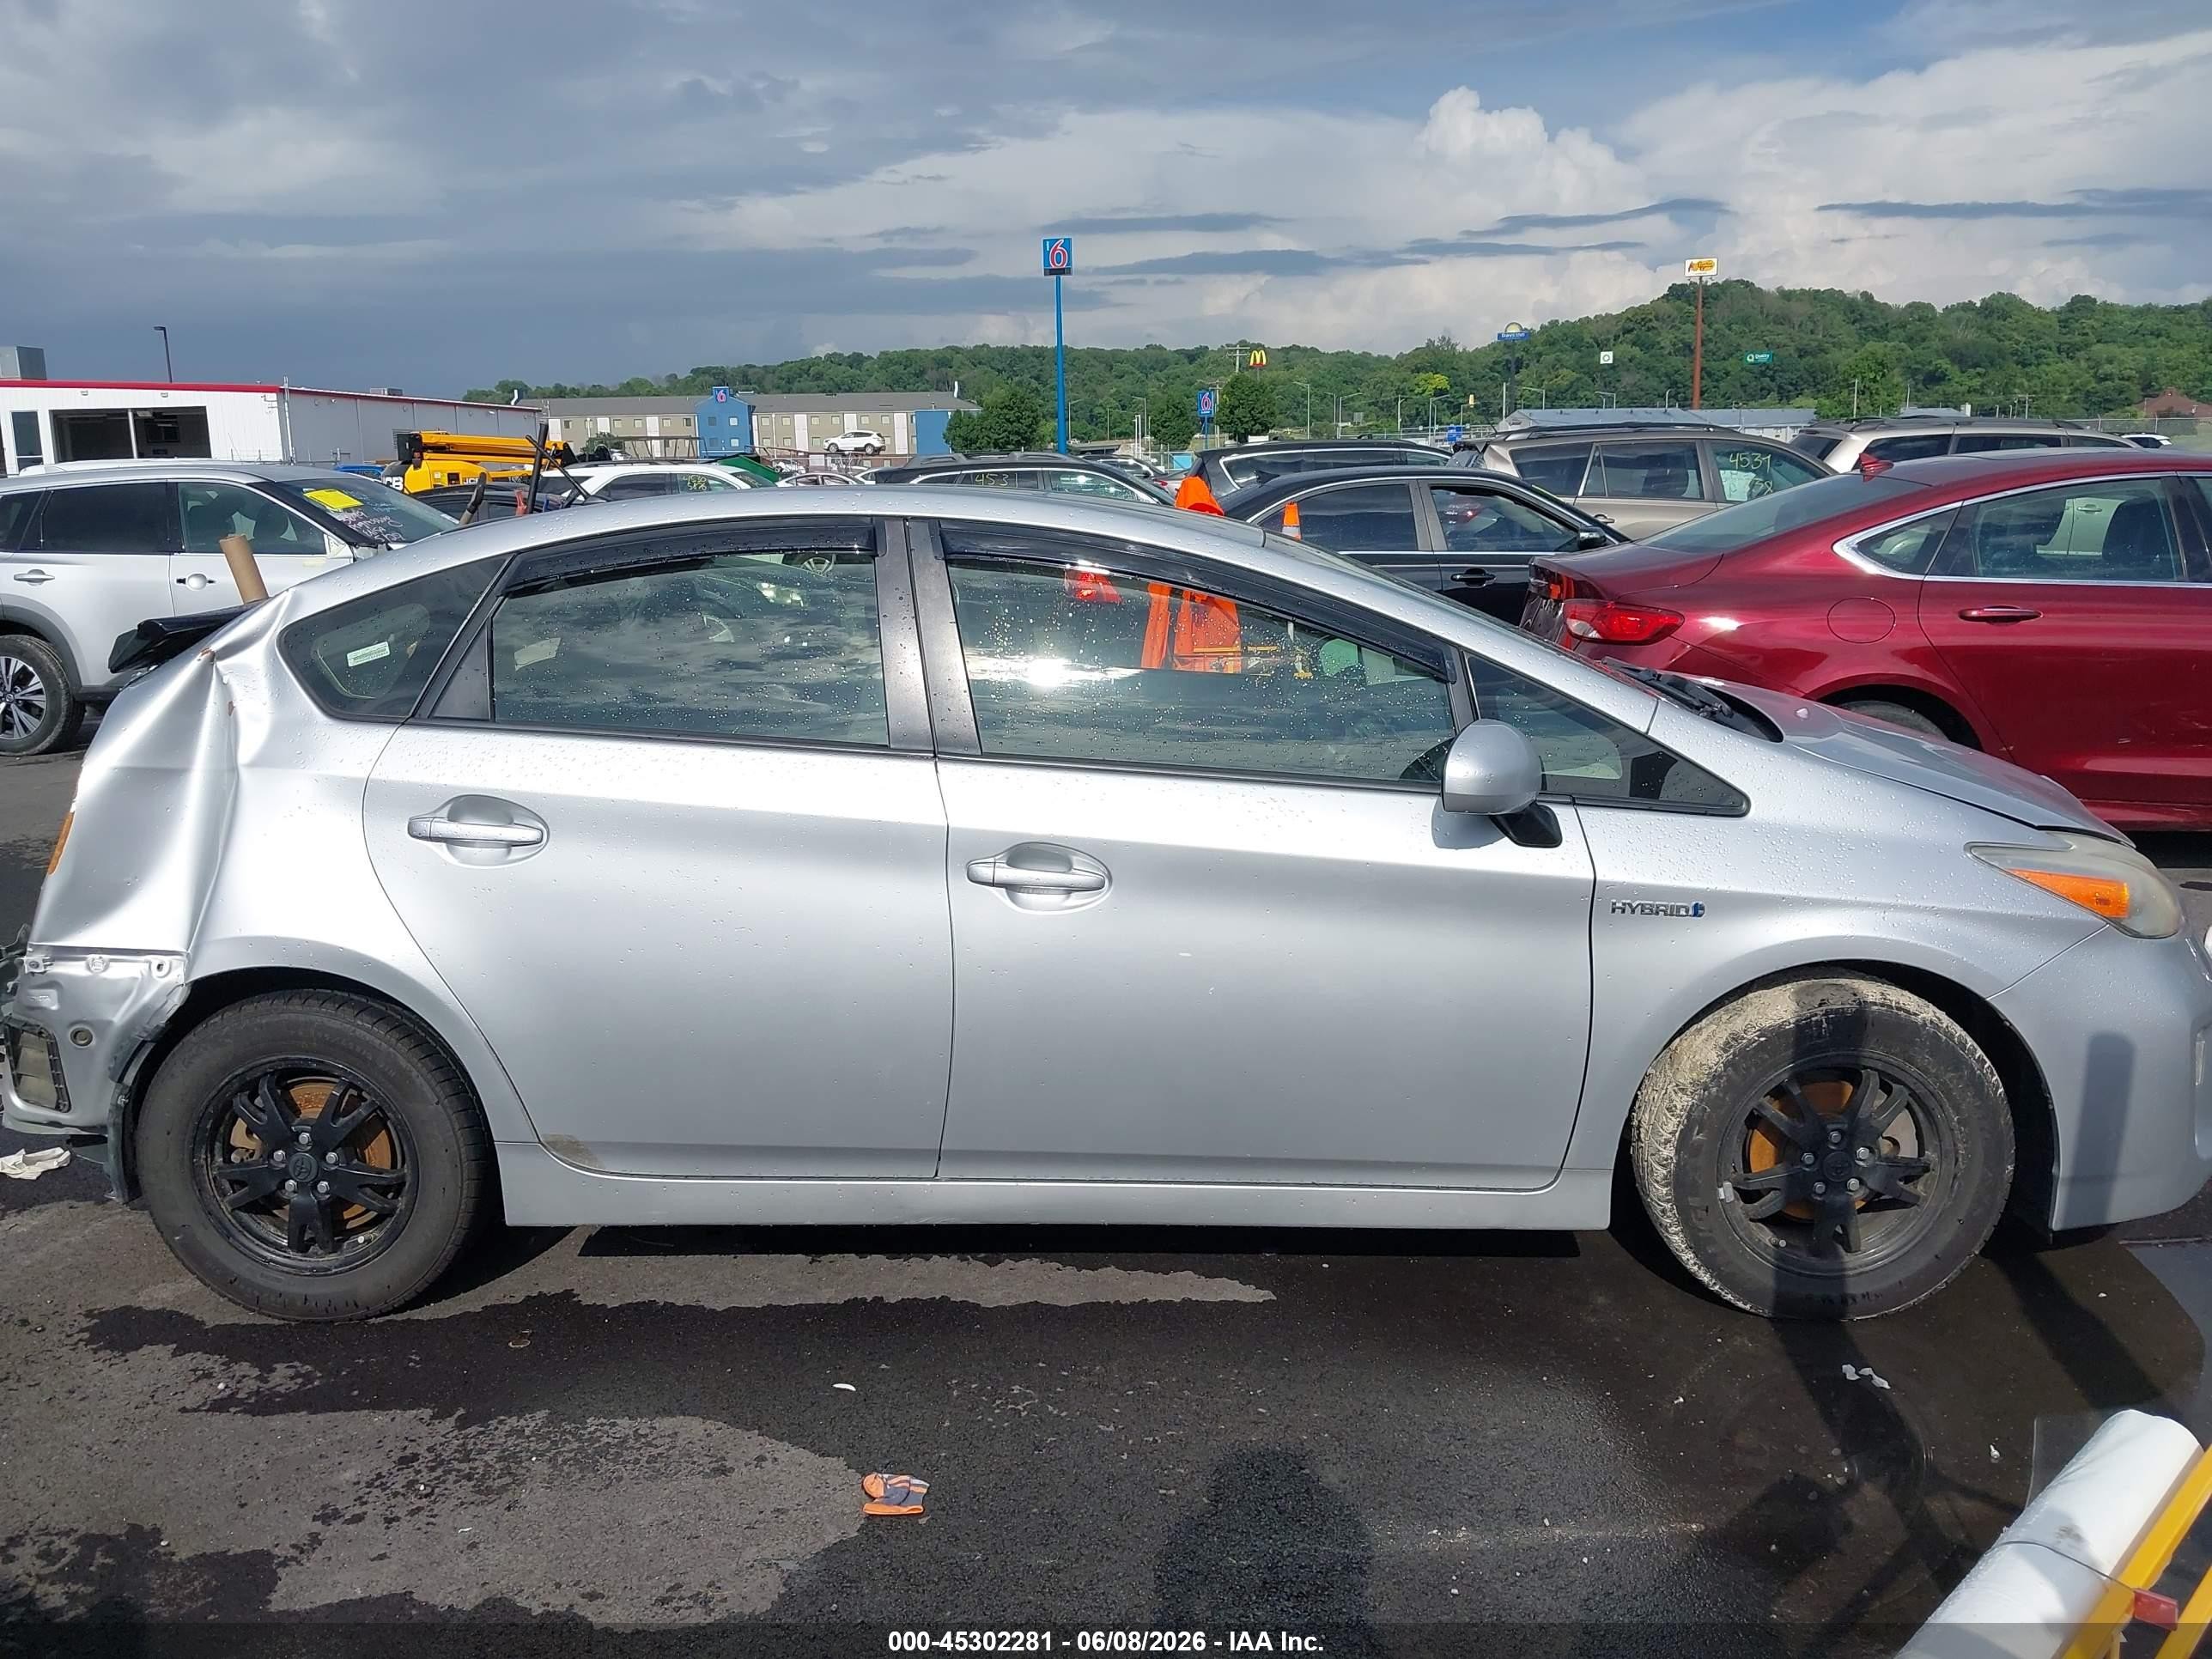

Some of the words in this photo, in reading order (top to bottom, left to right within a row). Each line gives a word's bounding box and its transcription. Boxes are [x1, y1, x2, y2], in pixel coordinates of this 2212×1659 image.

[1048, 239, 1068, 269] 6
[717, 389, 726, 403] 6
[1201, 392, 1212, 410] 6
[975, 472, 1018, 489] 4531
[1611, 899, 1690, 918] HYBRID
